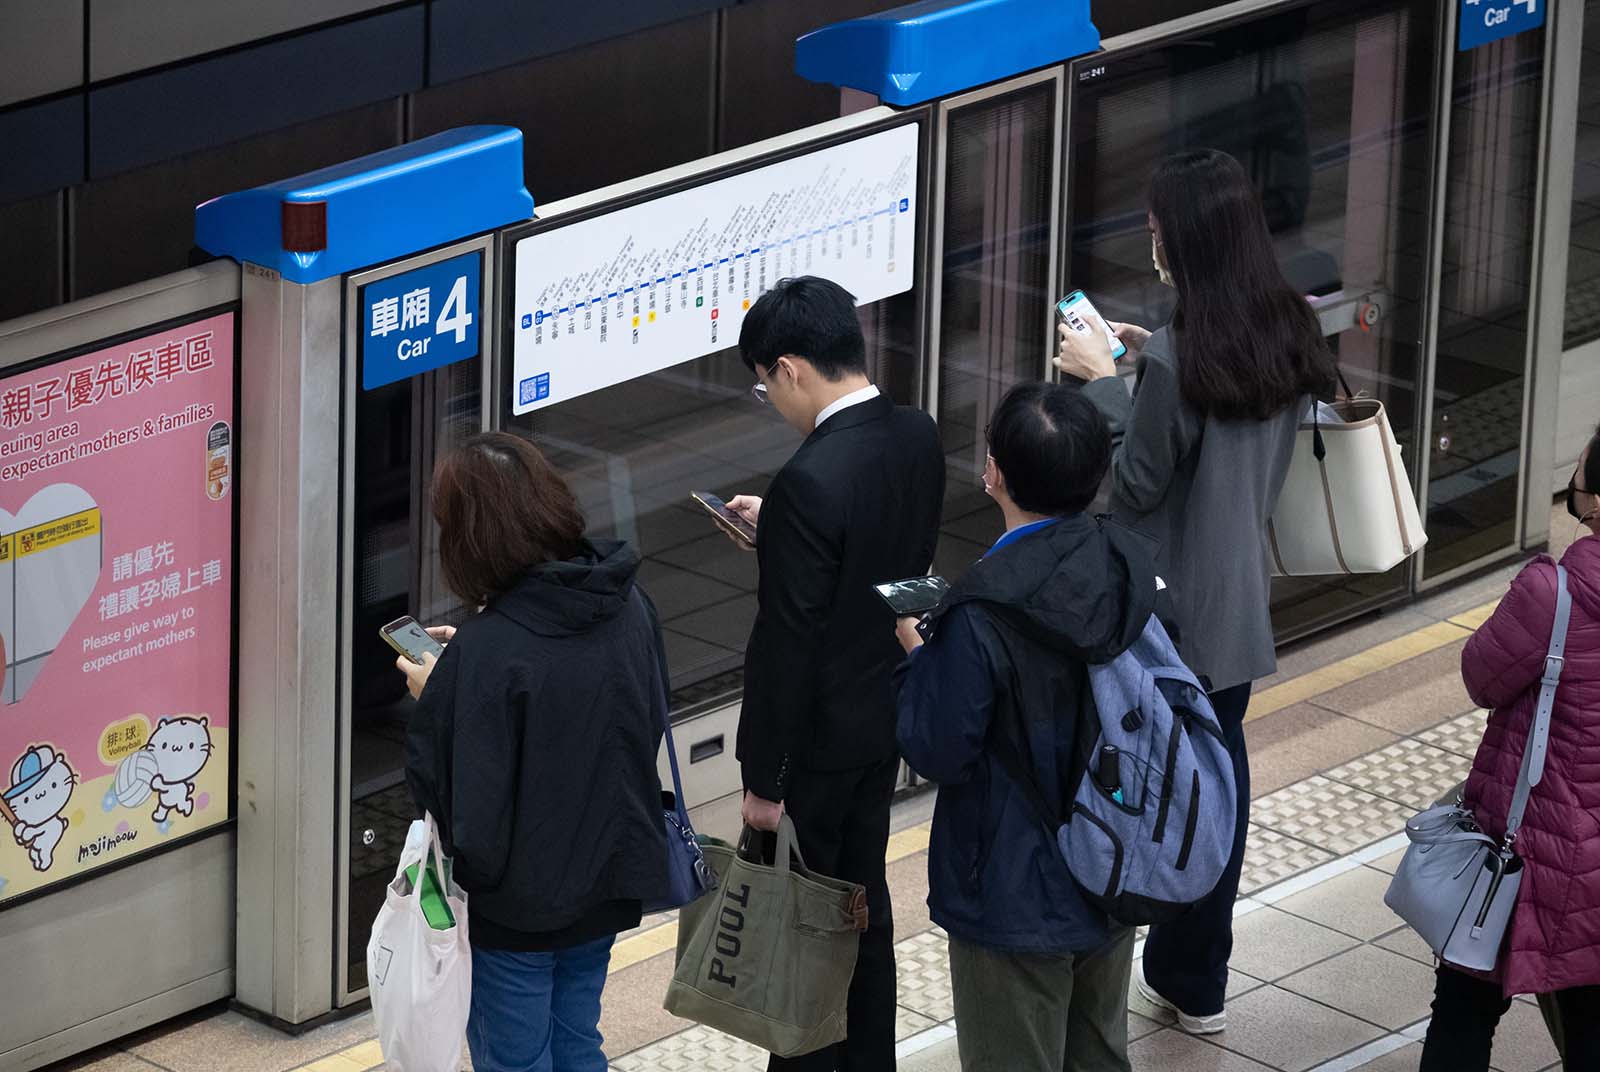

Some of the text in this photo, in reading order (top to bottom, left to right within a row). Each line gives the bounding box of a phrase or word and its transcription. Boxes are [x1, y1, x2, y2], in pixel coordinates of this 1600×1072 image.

[1484, 7, 1511, 27] Car
[370, 286, 431, 337] 車廂
[435, 275, 472, 344] 4
[397, 337, 432, 361] Car
[1, 332, 213, 428] 親子優先候車區
[1, 422, 79, 456] euing area
[2, 404, 213, 480] expectant mothers & families
[113, 541, 174, 582] 請優先
[99, 560, 222, 621] 禮讓孕婦上車
[83, 606, 194, 653] Please give way to
[83, 626, 196, 673] expectant mothers
[708, 884, 751, 989] POOL
